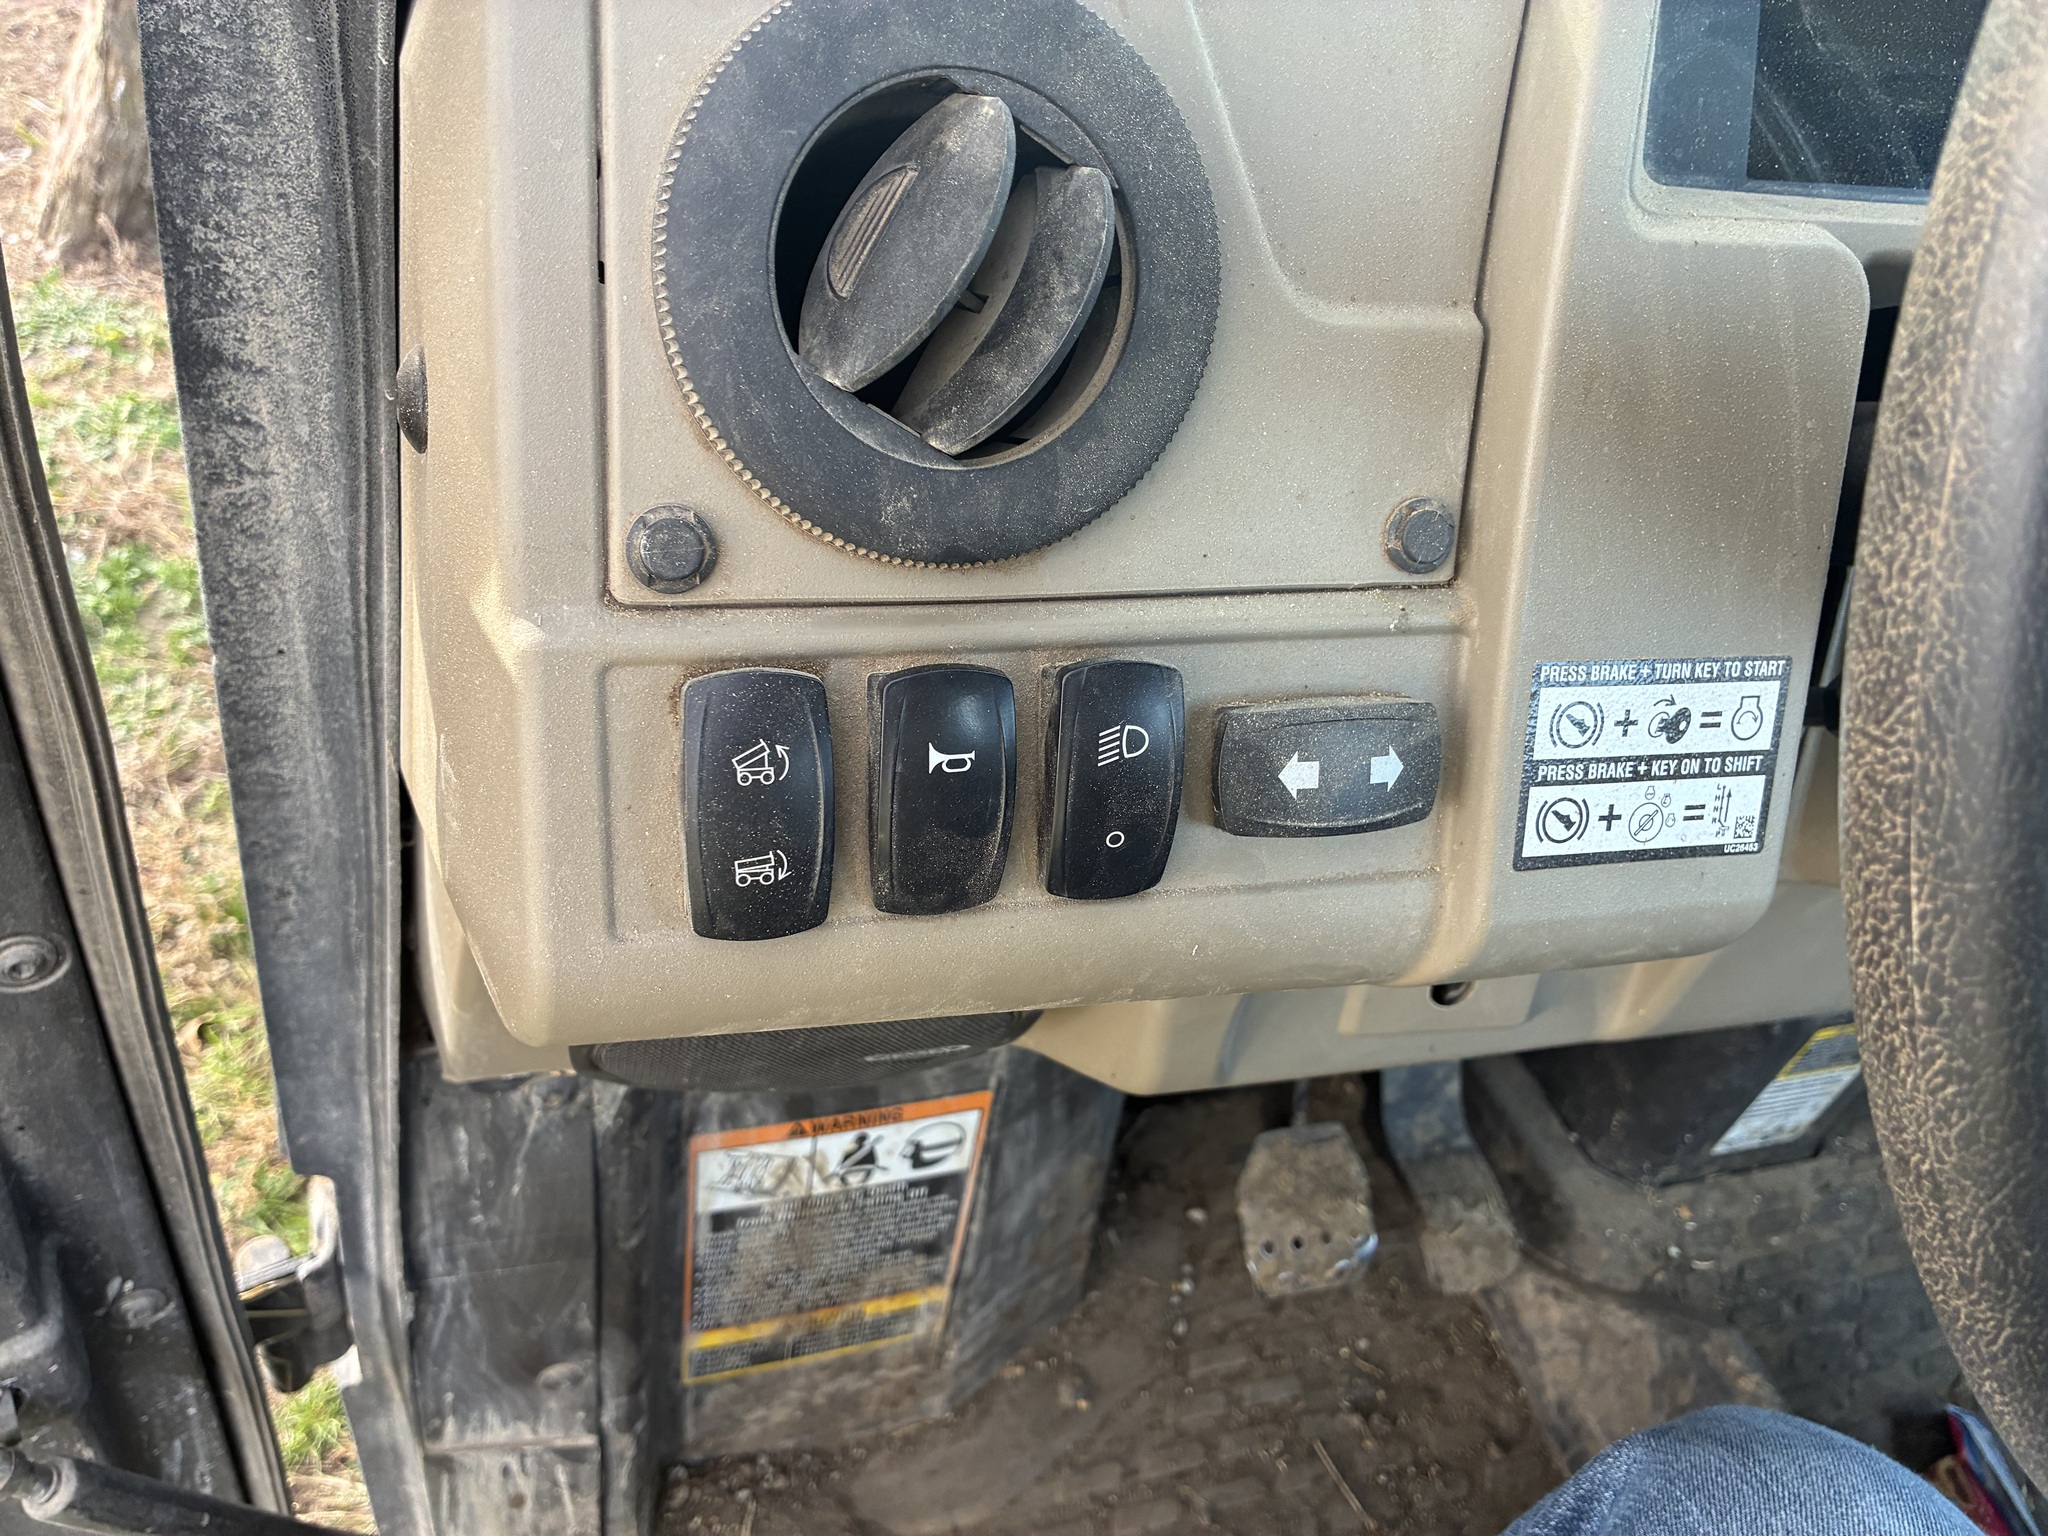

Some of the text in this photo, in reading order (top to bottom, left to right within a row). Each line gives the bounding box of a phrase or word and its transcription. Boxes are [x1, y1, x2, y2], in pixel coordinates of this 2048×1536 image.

[1540, 665, 1587, 682] PRESS
[1591, 664, 1637, 681] BRAKE
[1654, 663, 1692, 680] TURN
[1694, 662, 1720, 679] KEY
[1723, 661, 1741, 678] TO
[1744, 660, 1786, 677] START
[1537, 764, 1584, 782] PRESS
[1587, 762, 1634, 780] BRAKE
[1651, 760, 1678, 776] KEY
[1680, 758, 1700, 775] ON
[1704, 757, 1722, 774] TO
[1724, 755, 1764, 773] SHIFT
